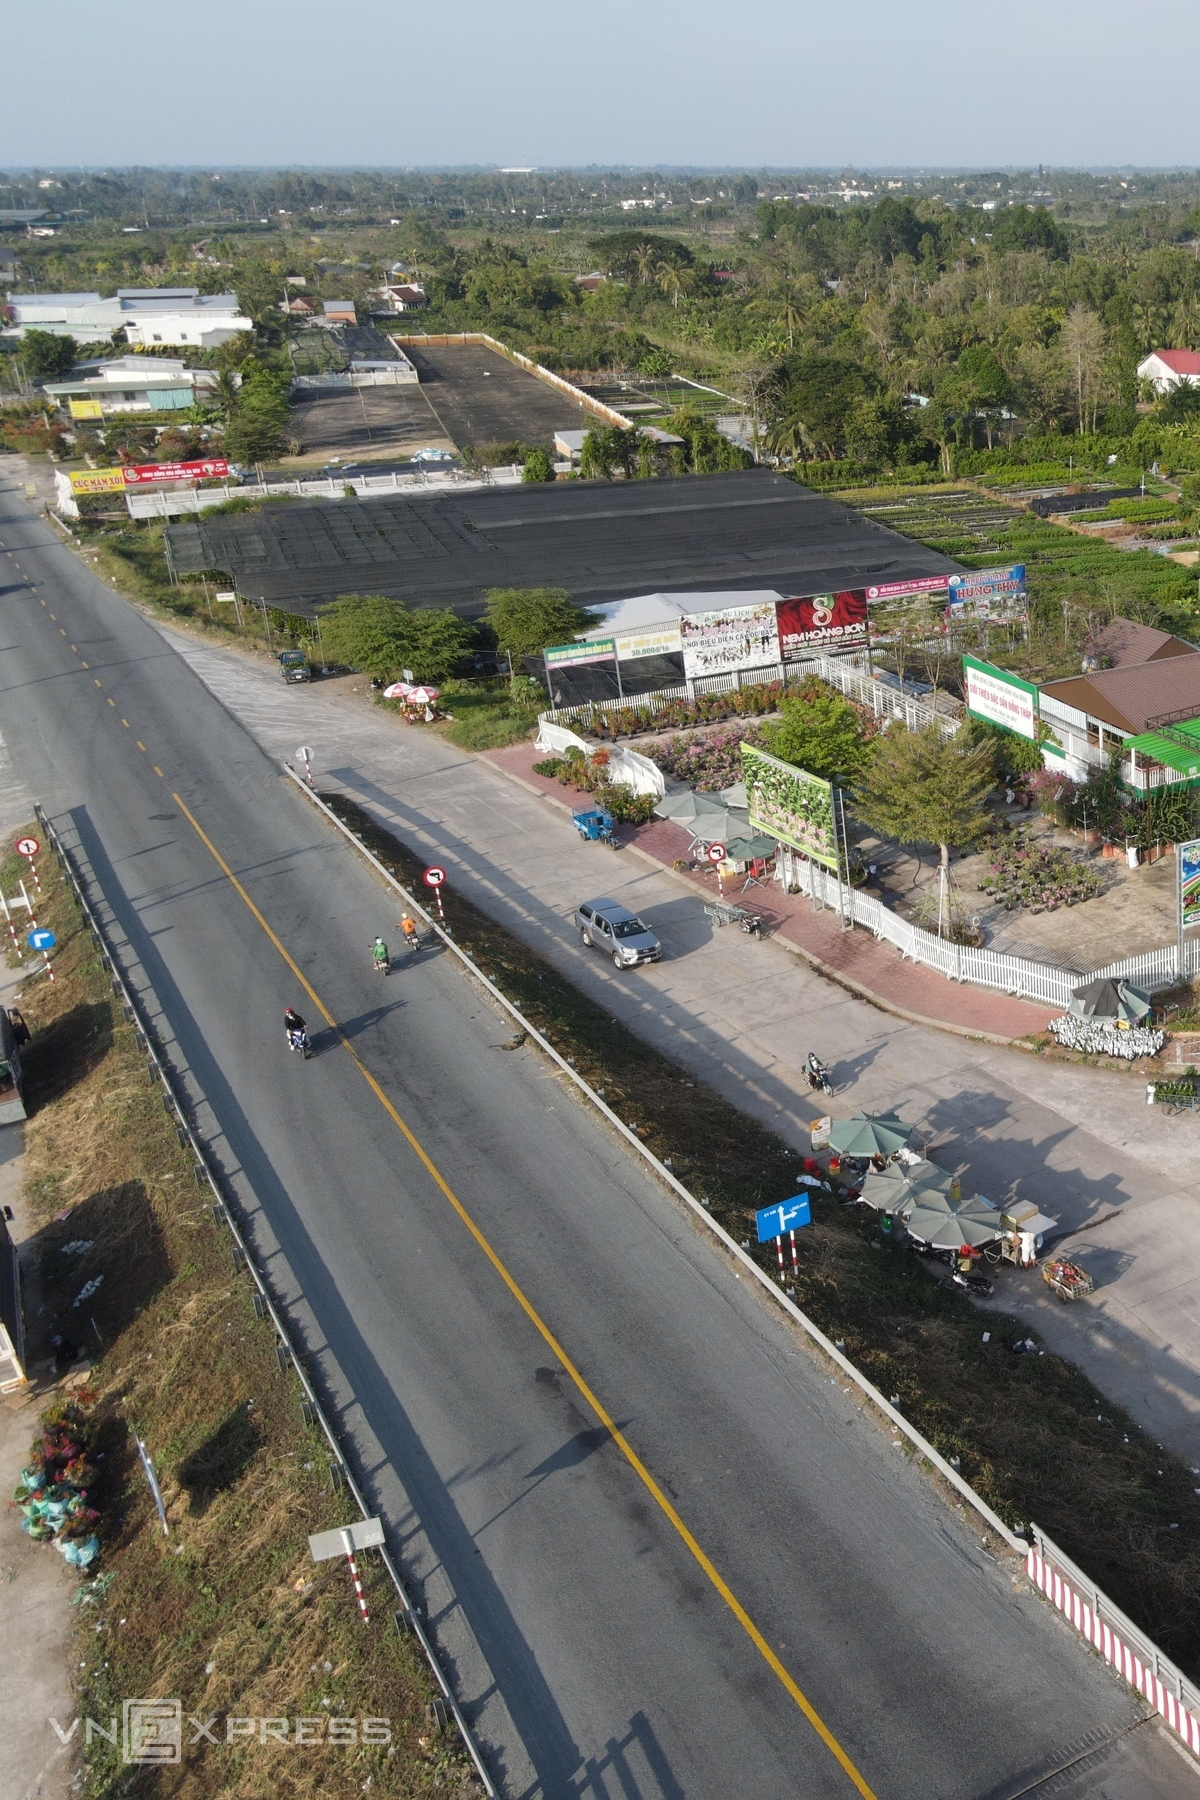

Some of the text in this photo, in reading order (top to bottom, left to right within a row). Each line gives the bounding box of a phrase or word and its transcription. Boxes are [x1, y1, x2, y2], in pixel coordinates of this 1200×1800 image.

[965, 572, 1010, 585] HAPPY LAND
[782, 632, 804, 644] NEM
